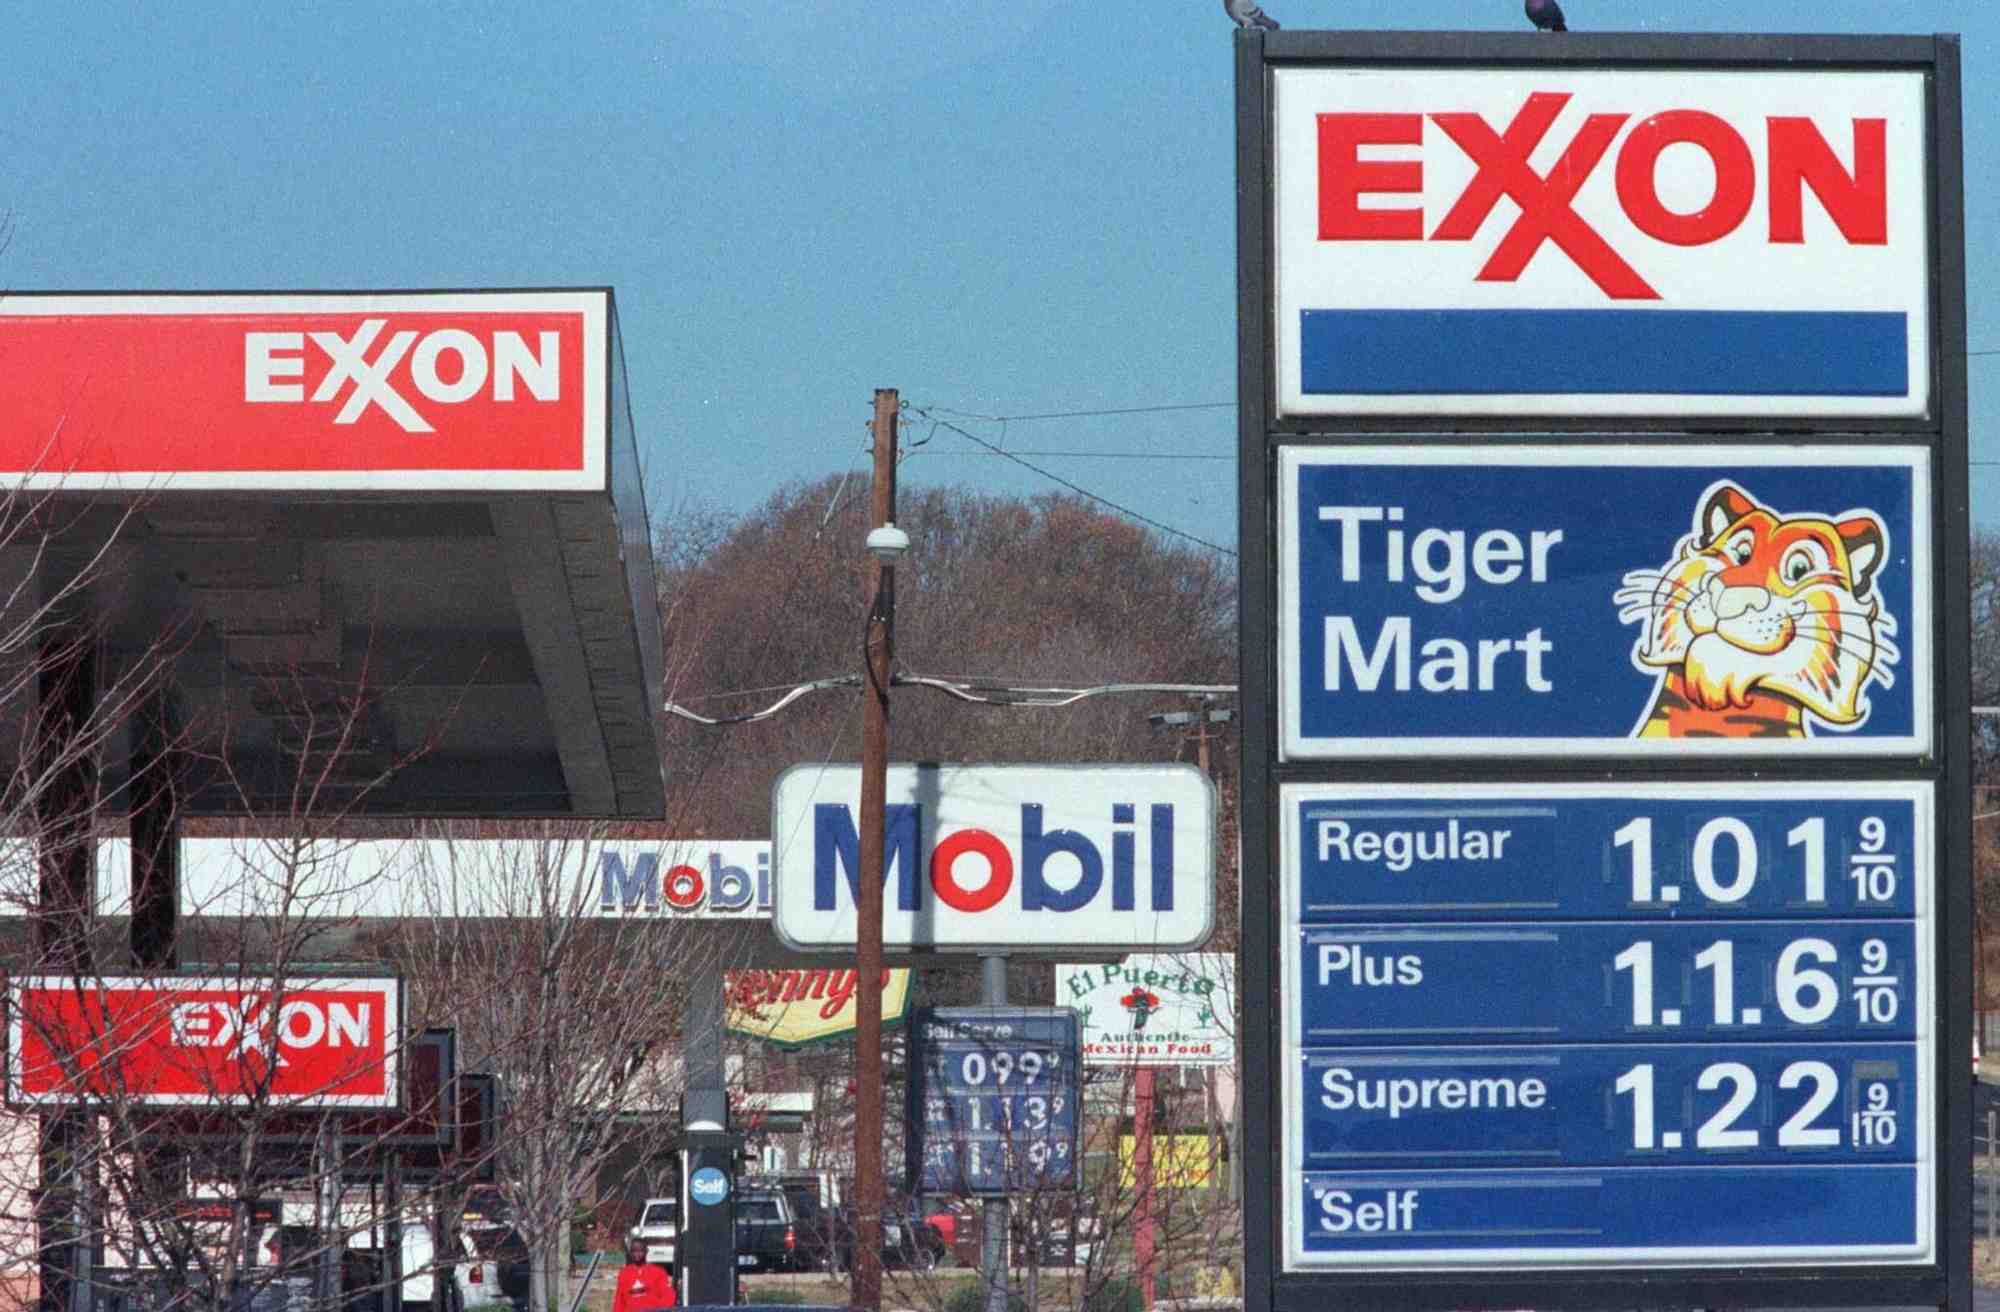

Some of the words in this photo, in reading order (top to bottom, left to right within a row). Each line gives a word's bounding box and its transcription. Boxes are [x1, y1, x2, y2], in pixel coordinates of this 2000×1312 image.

[1316, 92, 1888, 300] EXXON
[245, 319, 560, 432] EXXON
[1319, 507, 1563, 603] Tiger
[1323, 615, 1553, 692] Mart
[813, 802, 1175, 913] Mobil
[1318, 818, 1512, 872] Regular
[1614, 816, 1826, 903] 1.01
[1102, 963, 1216, 995] Puerto
[1318, 944, 1424, 986] Plus
[171, 993, 371, 1068] EXXON
[1101, 1031, 1191, 1042] Authentic
[1167, 1042, 1213, 1055] Food
[1321, 1068, 1547, 1118] Supreme
[1616, 1060, 1841, 1149] 1.22
[694, 1178, 724, 1194] Self
[1320, 1190, 1418, 1231] Self
